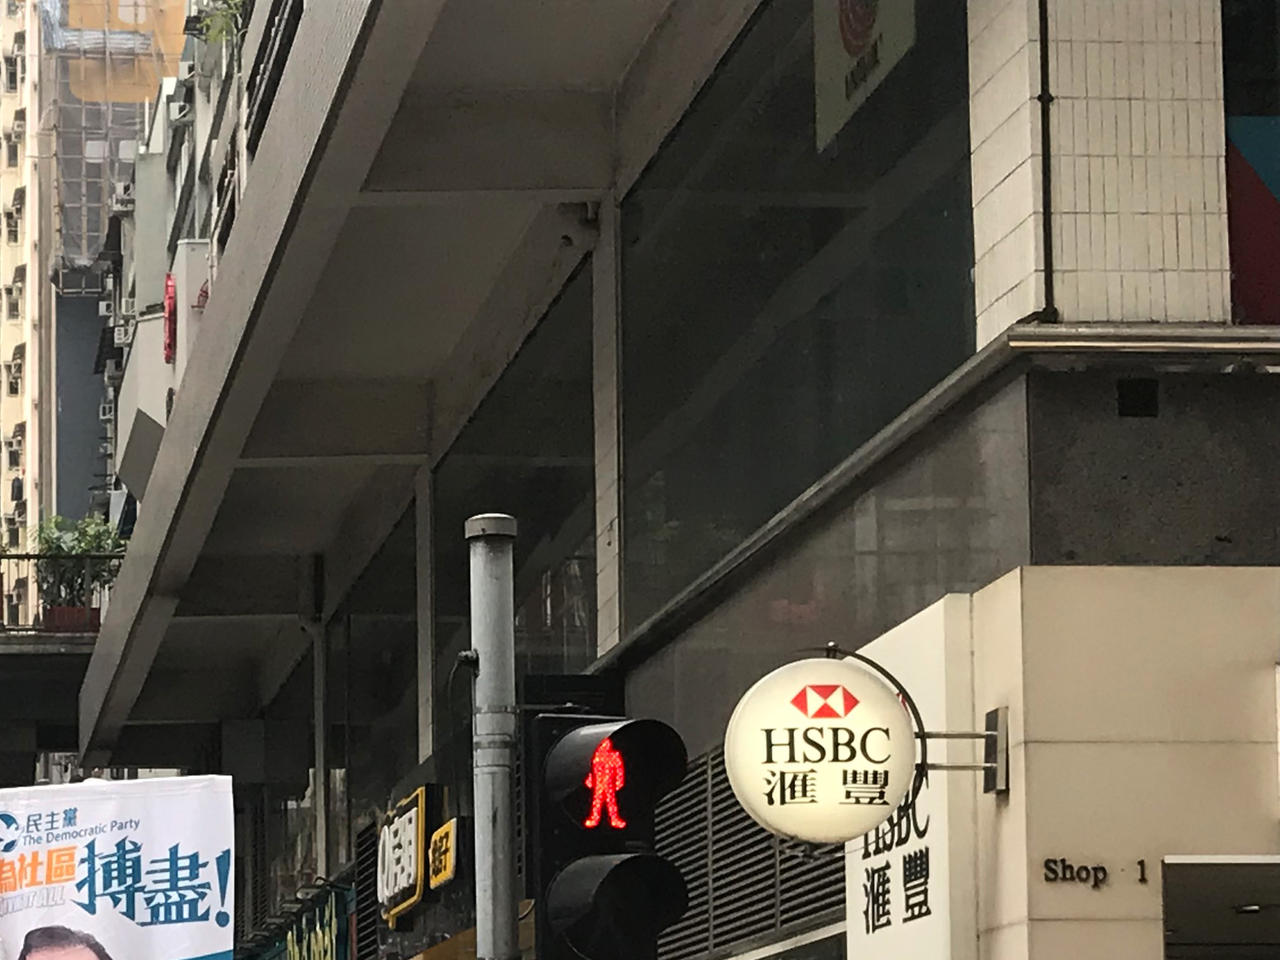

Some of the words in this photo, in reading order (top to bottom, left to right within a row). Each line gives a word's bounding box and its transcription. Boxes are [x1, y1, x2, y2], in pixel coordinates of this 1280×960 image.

[760, 726, 891, 764] HSBC
[23, 833, 43, 847] The
[46, 823, 108, 845] Democratic
[110, 817, 141, 833] Party
[25, 807, 79, 834] 民主黨
[1043, 857, 1108, 889] Shop
[1137, 859, 1148, 885] 1
